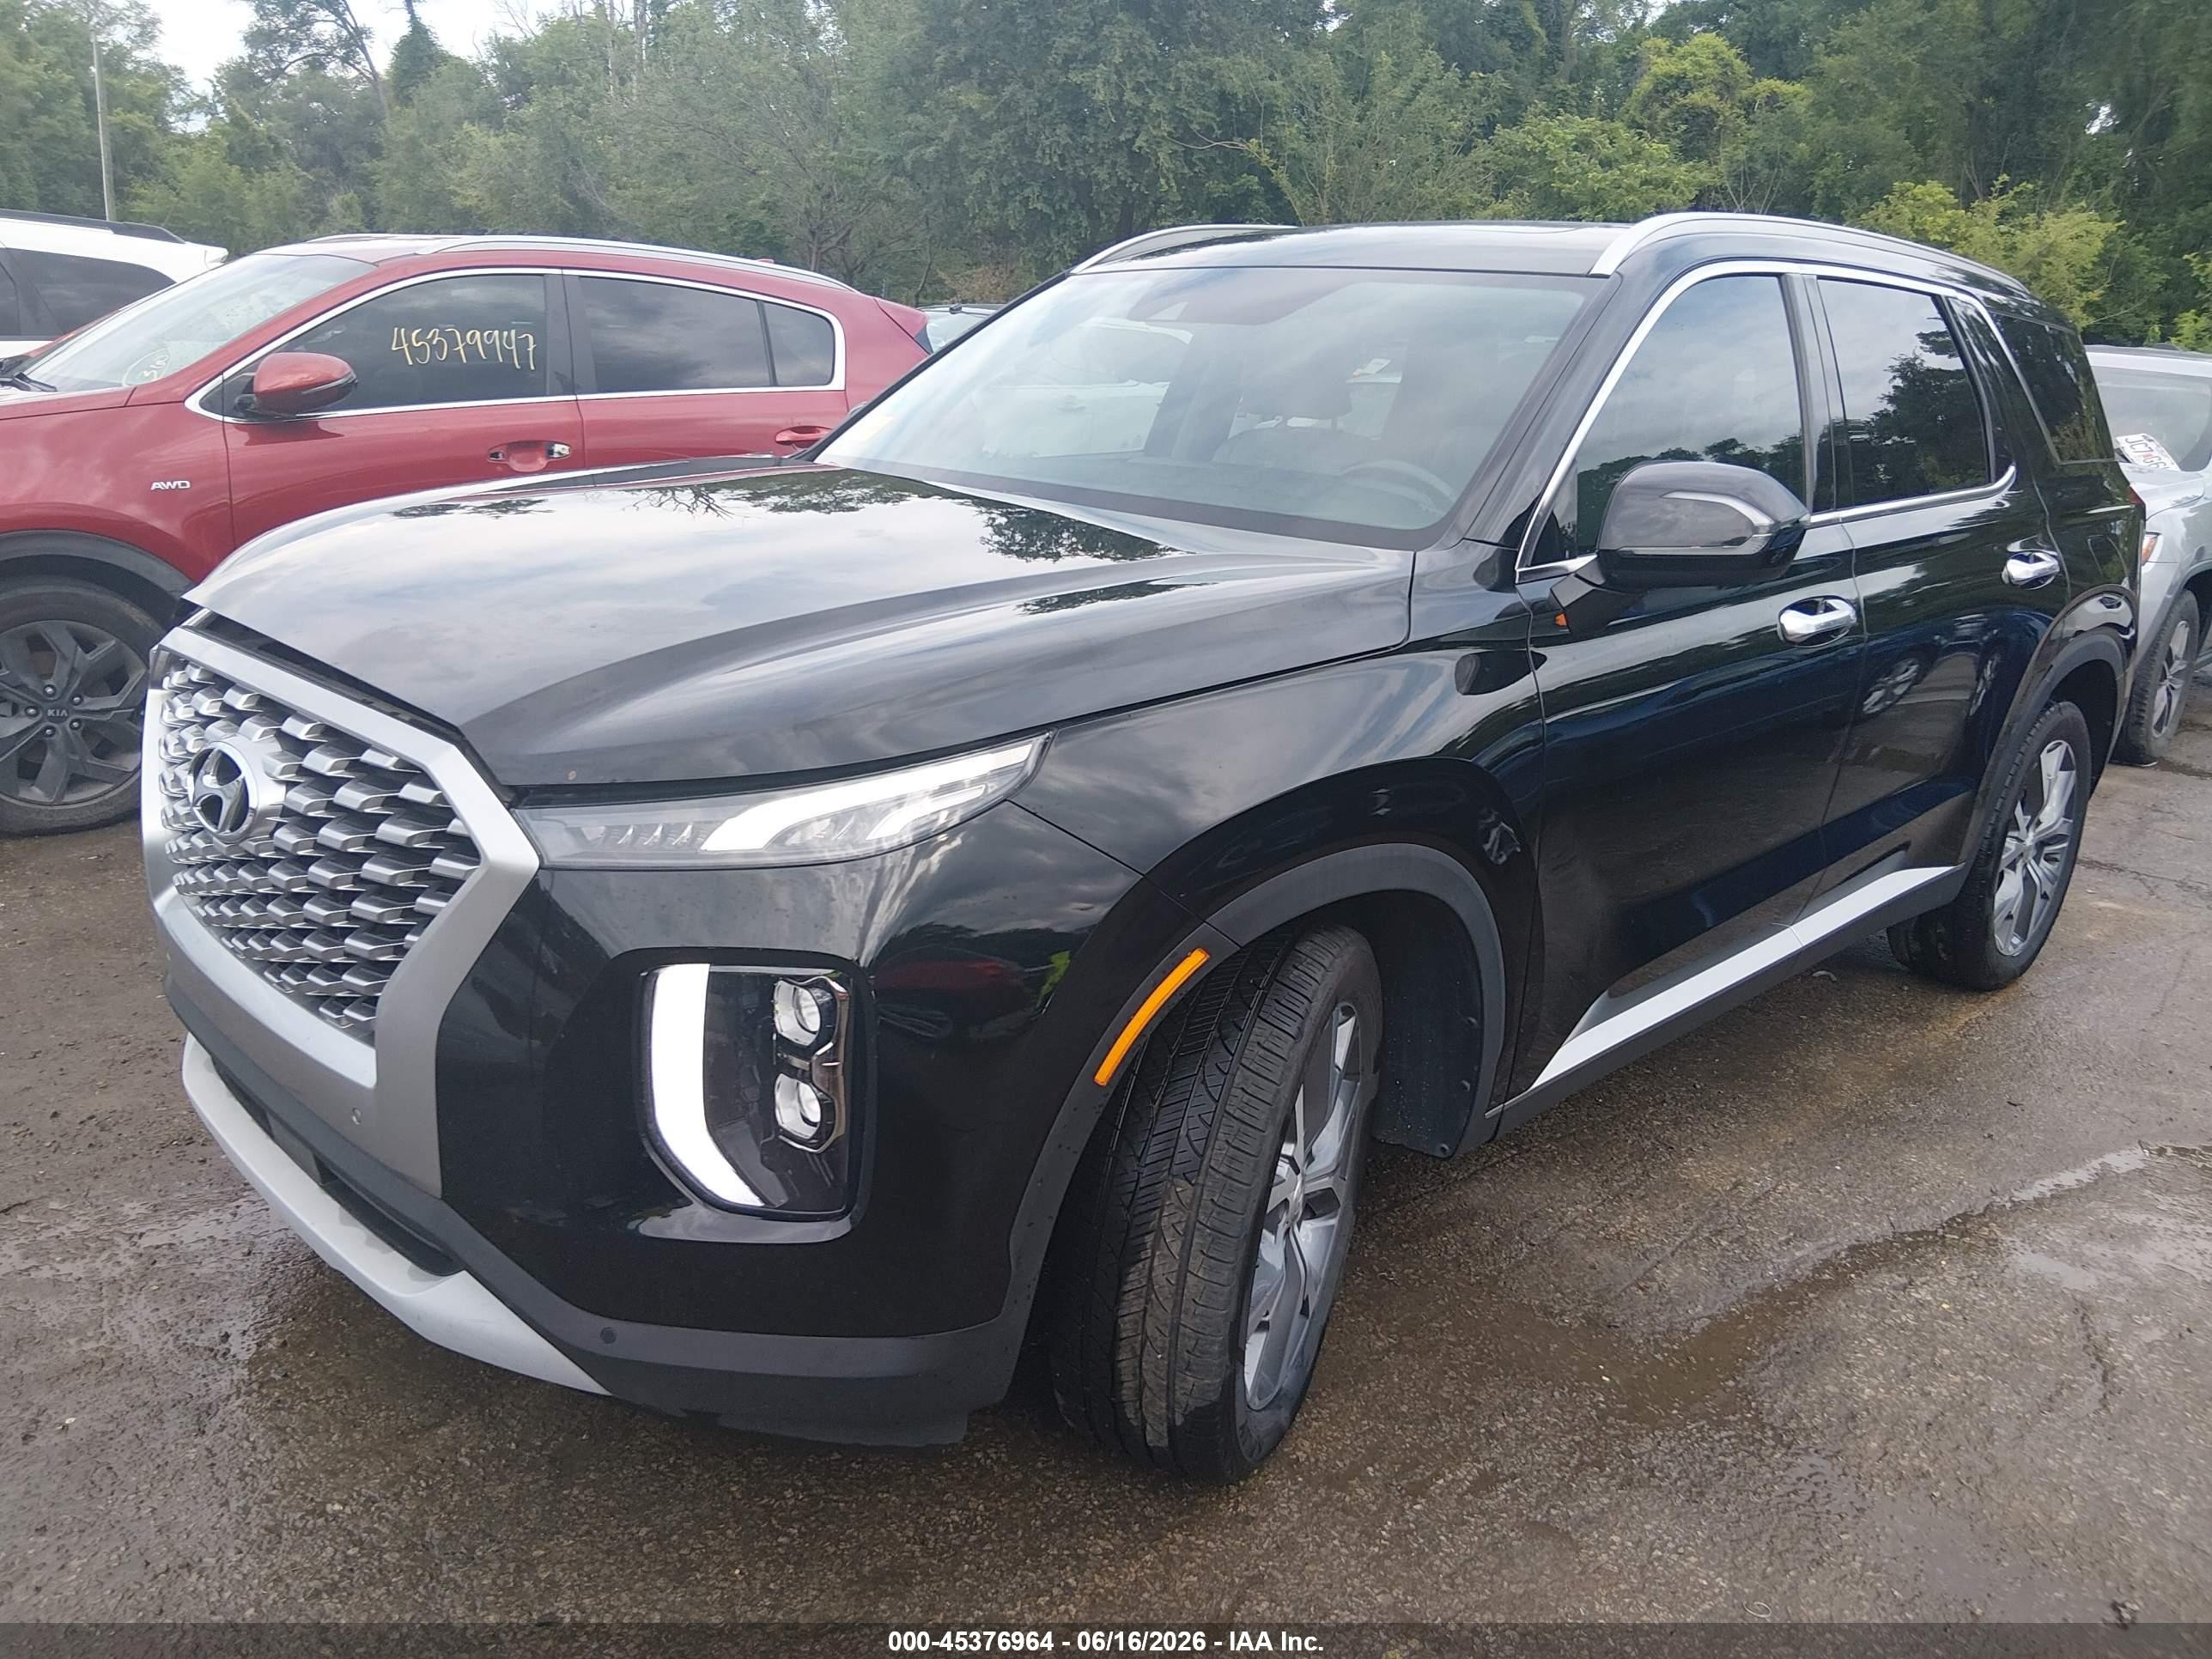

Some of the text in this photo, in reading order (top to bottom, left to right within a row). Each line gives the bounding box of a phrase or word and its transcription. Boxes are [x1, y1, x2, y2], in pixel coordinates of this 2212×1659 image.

[392, 327, 537, 370] 45379947
[150, 480, 191, 490] AWD
[47, 708, 69, 717] KIA
